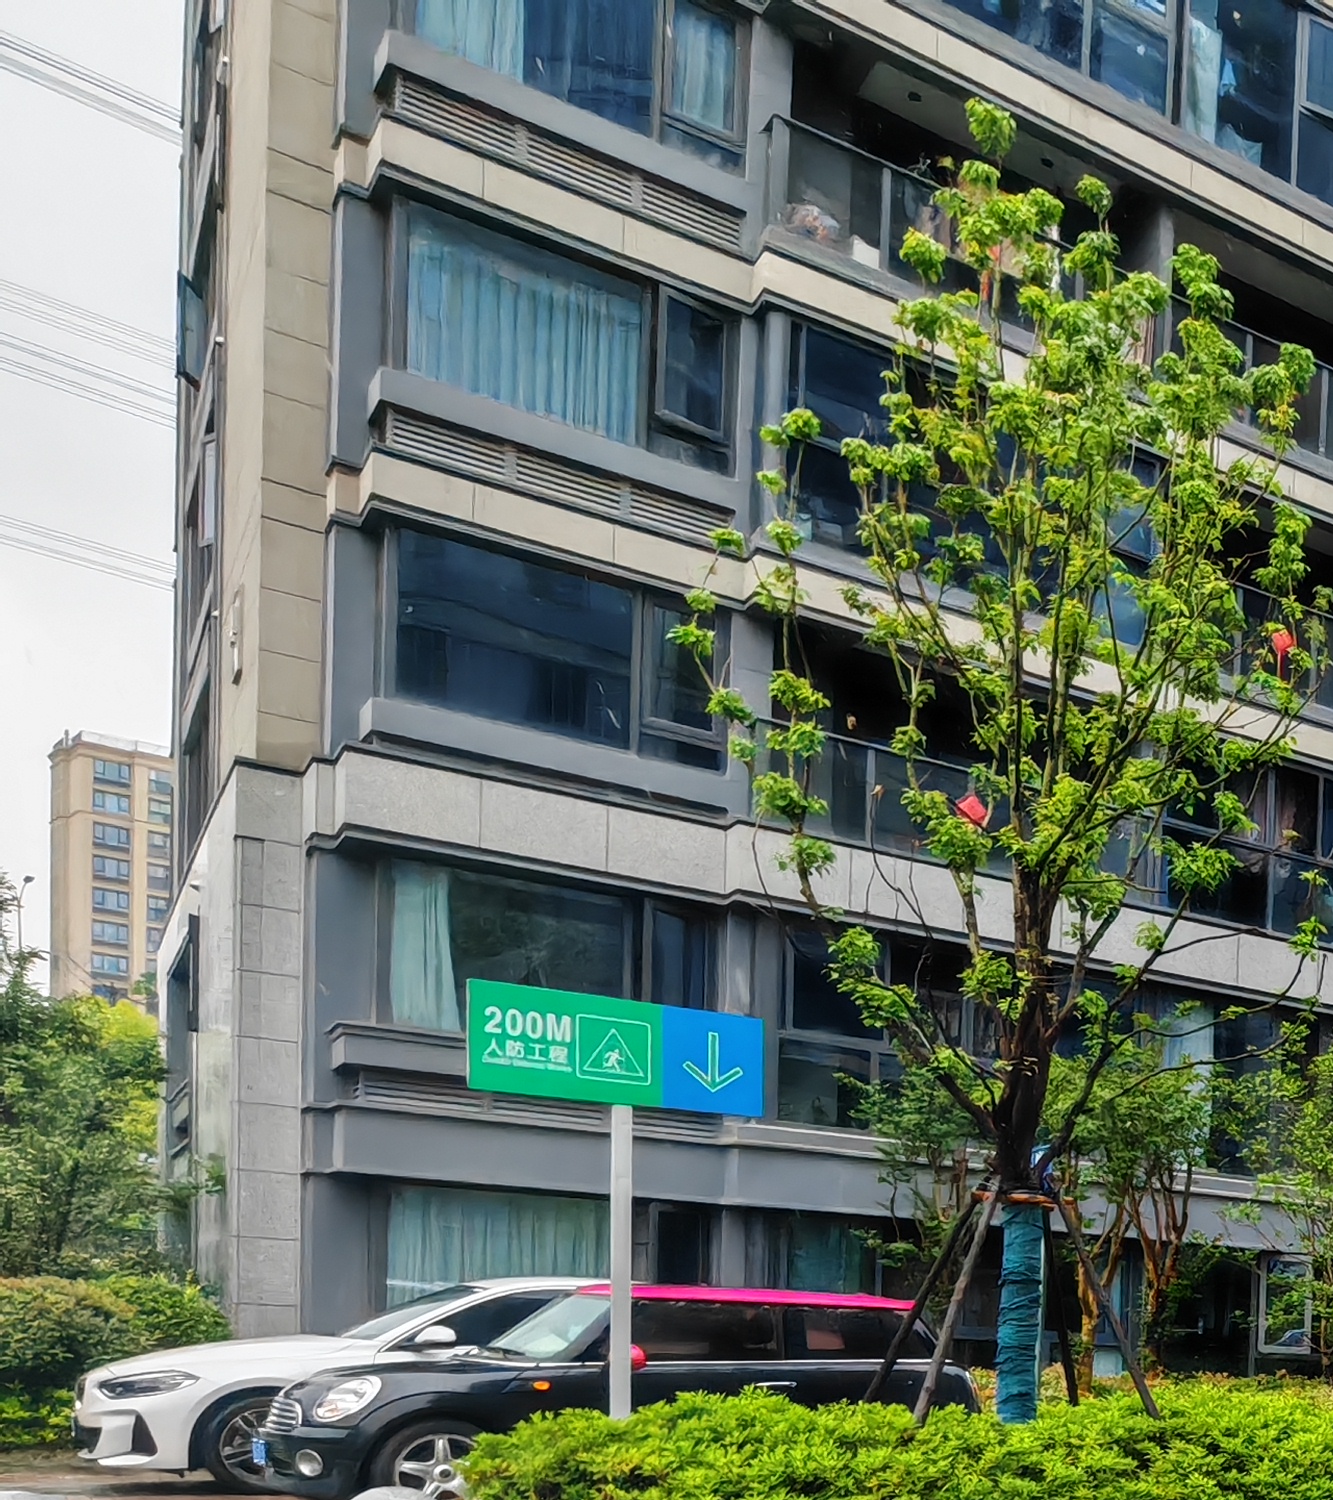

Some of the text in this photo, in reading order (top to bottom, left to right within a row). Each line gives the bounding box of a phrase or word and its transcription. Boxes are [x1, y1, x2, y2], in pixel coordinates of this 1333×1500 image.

[483, 1006, 572, 1043] 200M
[483, 1037, 569, 1064] 人防工程
